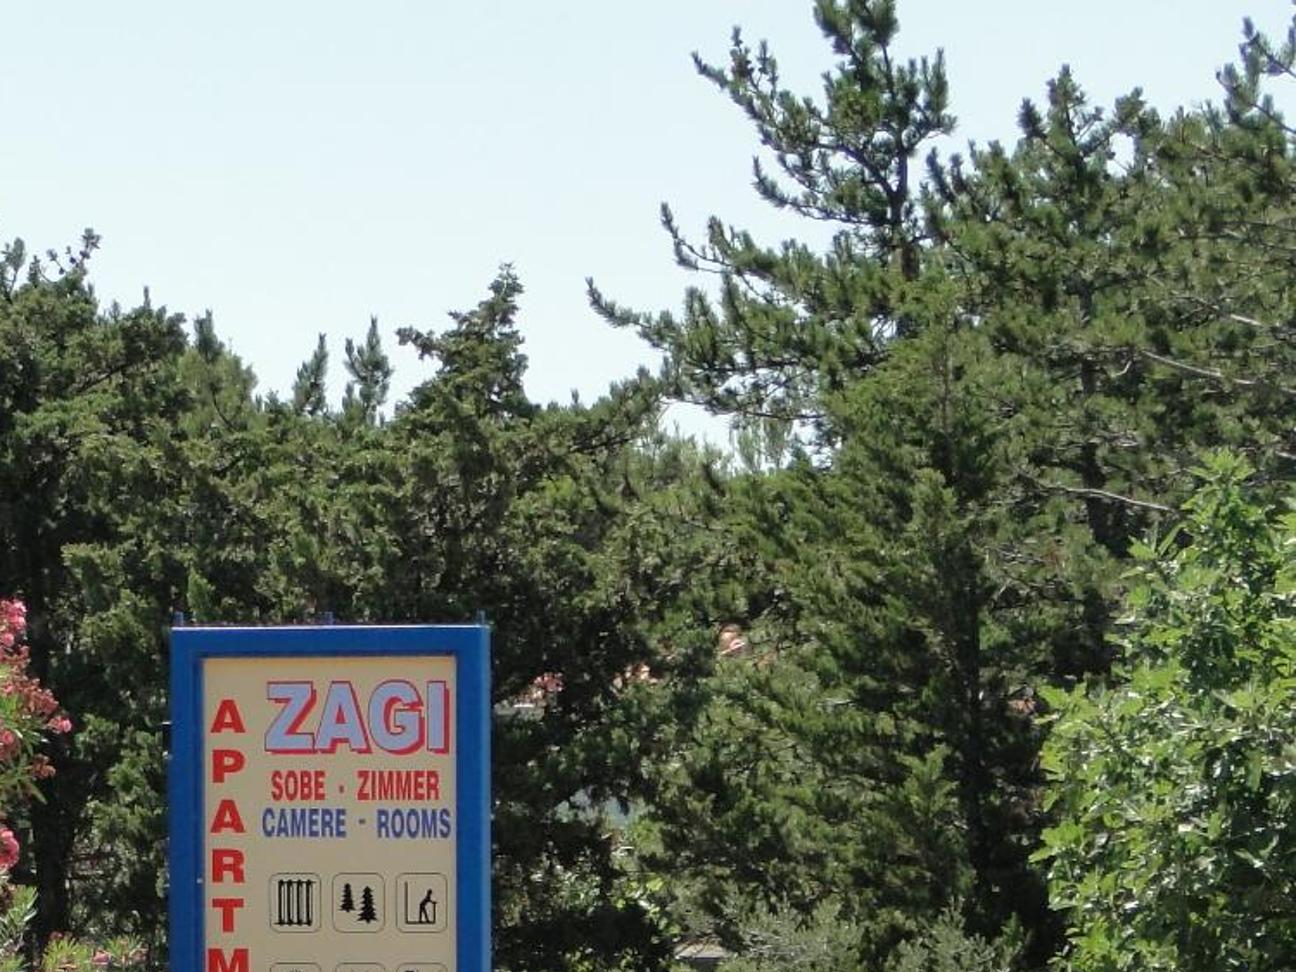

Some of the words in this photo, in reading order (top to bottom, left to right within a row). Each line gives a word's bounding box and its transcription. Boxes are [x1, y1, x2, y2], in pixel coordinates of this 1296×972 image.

[264, 679, 450, 755] ZAGI
[271, 770, 326, 801] SOBE
[357, 770, 440, 801] ZIMMER
[262, 807, 347, 839] CAMERE
[377, 807, 451, 839] ROOMS
